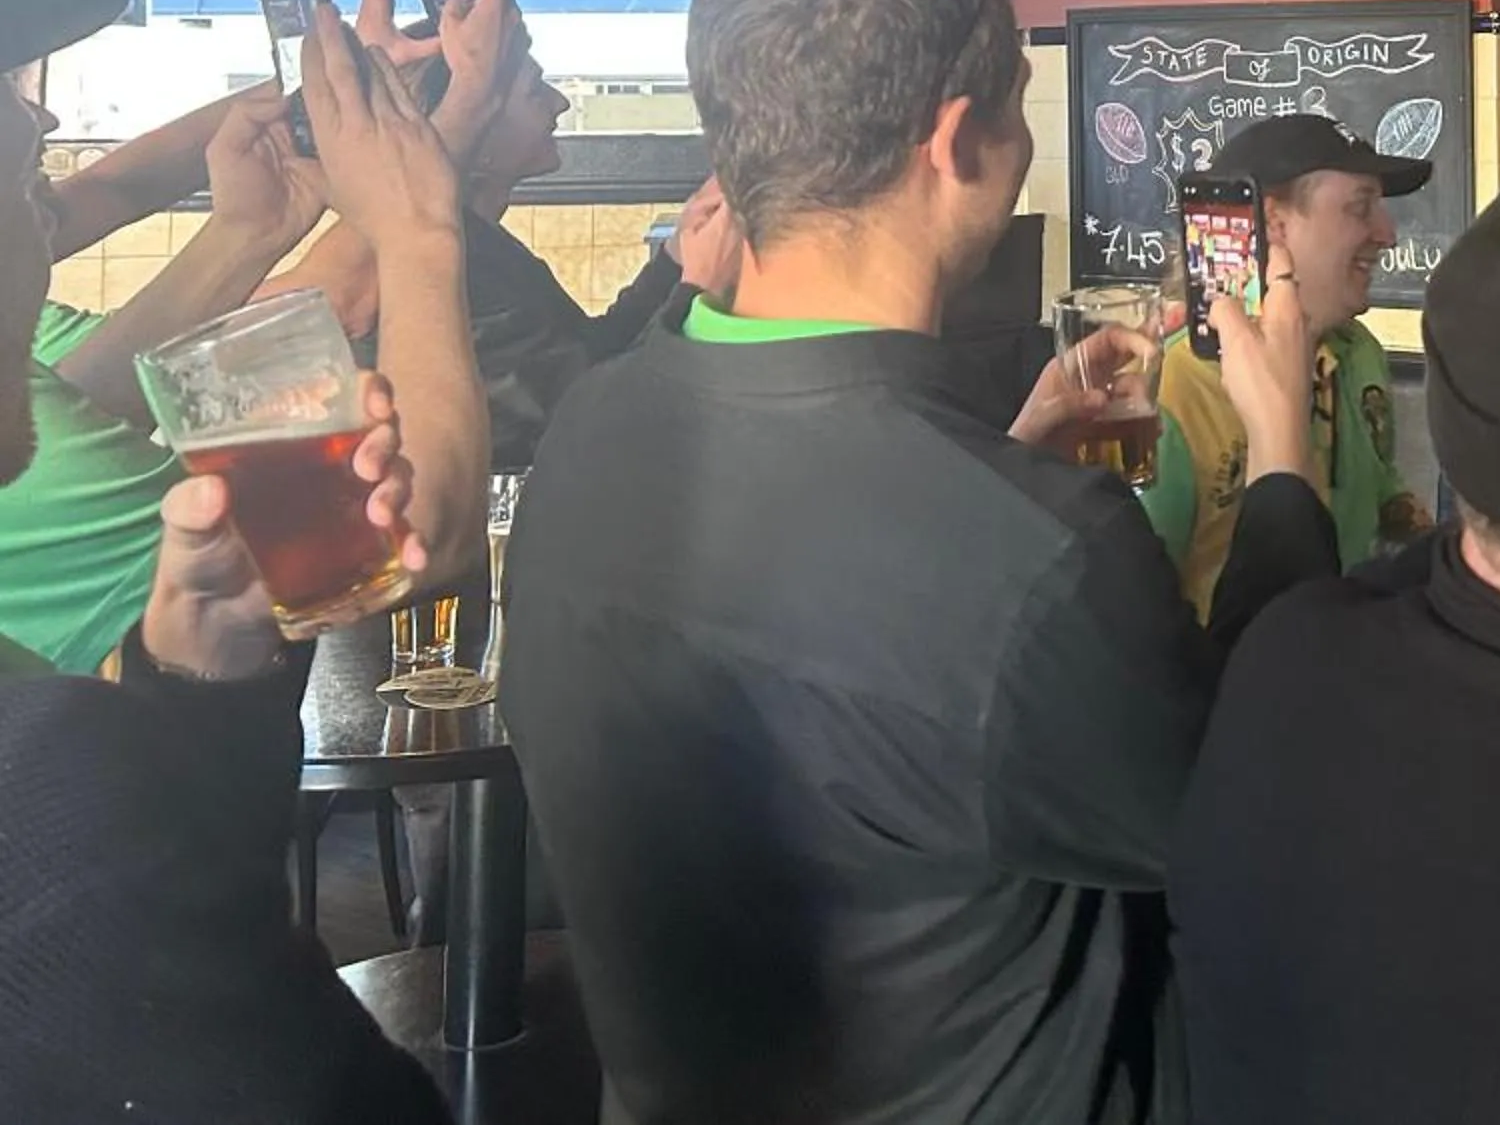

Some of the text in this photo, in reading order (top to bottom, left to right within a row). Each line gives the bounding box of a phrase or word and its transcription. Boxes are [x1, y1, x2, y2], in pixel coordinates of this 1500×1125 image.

[1139, 44, 1207, 72] STATE
[1307, 40, 1391, 67] ORIGIN
[1207, 94, 1267, 119] Game
